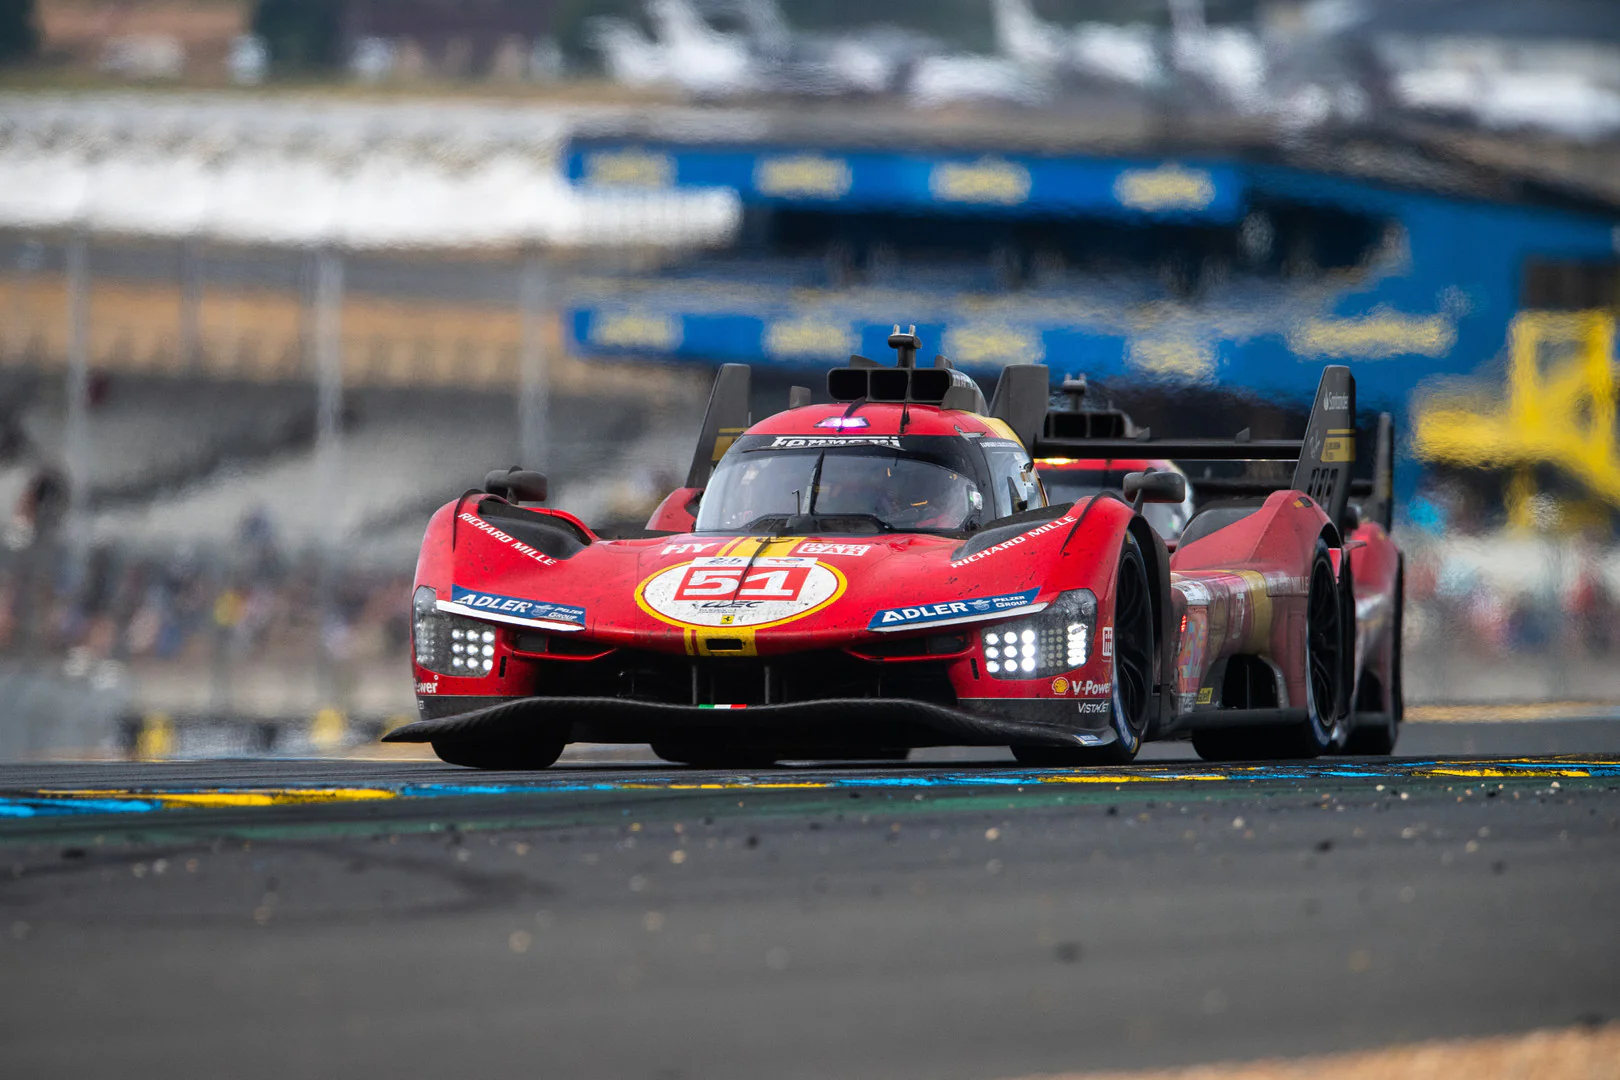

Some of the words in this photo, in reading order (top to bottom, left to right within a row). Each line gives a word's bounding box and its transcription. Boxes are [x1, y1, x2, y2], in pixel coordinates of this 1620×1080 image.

[458, 512, 510, 543] RICHARD
[511, 541, 557, 566] MILLE
[951, 536, 1026, 568] RICHARD
[1027, 515, 1078, 537] MILLE
[683, 570, 794, 596] 51
[453, 593, 533, 613] ADLER
[992, 595, 1025, 603] PELZER
[996, 600, 1028, 608] GROUP
[882, 602, 968, 623] ADLER
[1072, 680, 1111, 695] V-Power
